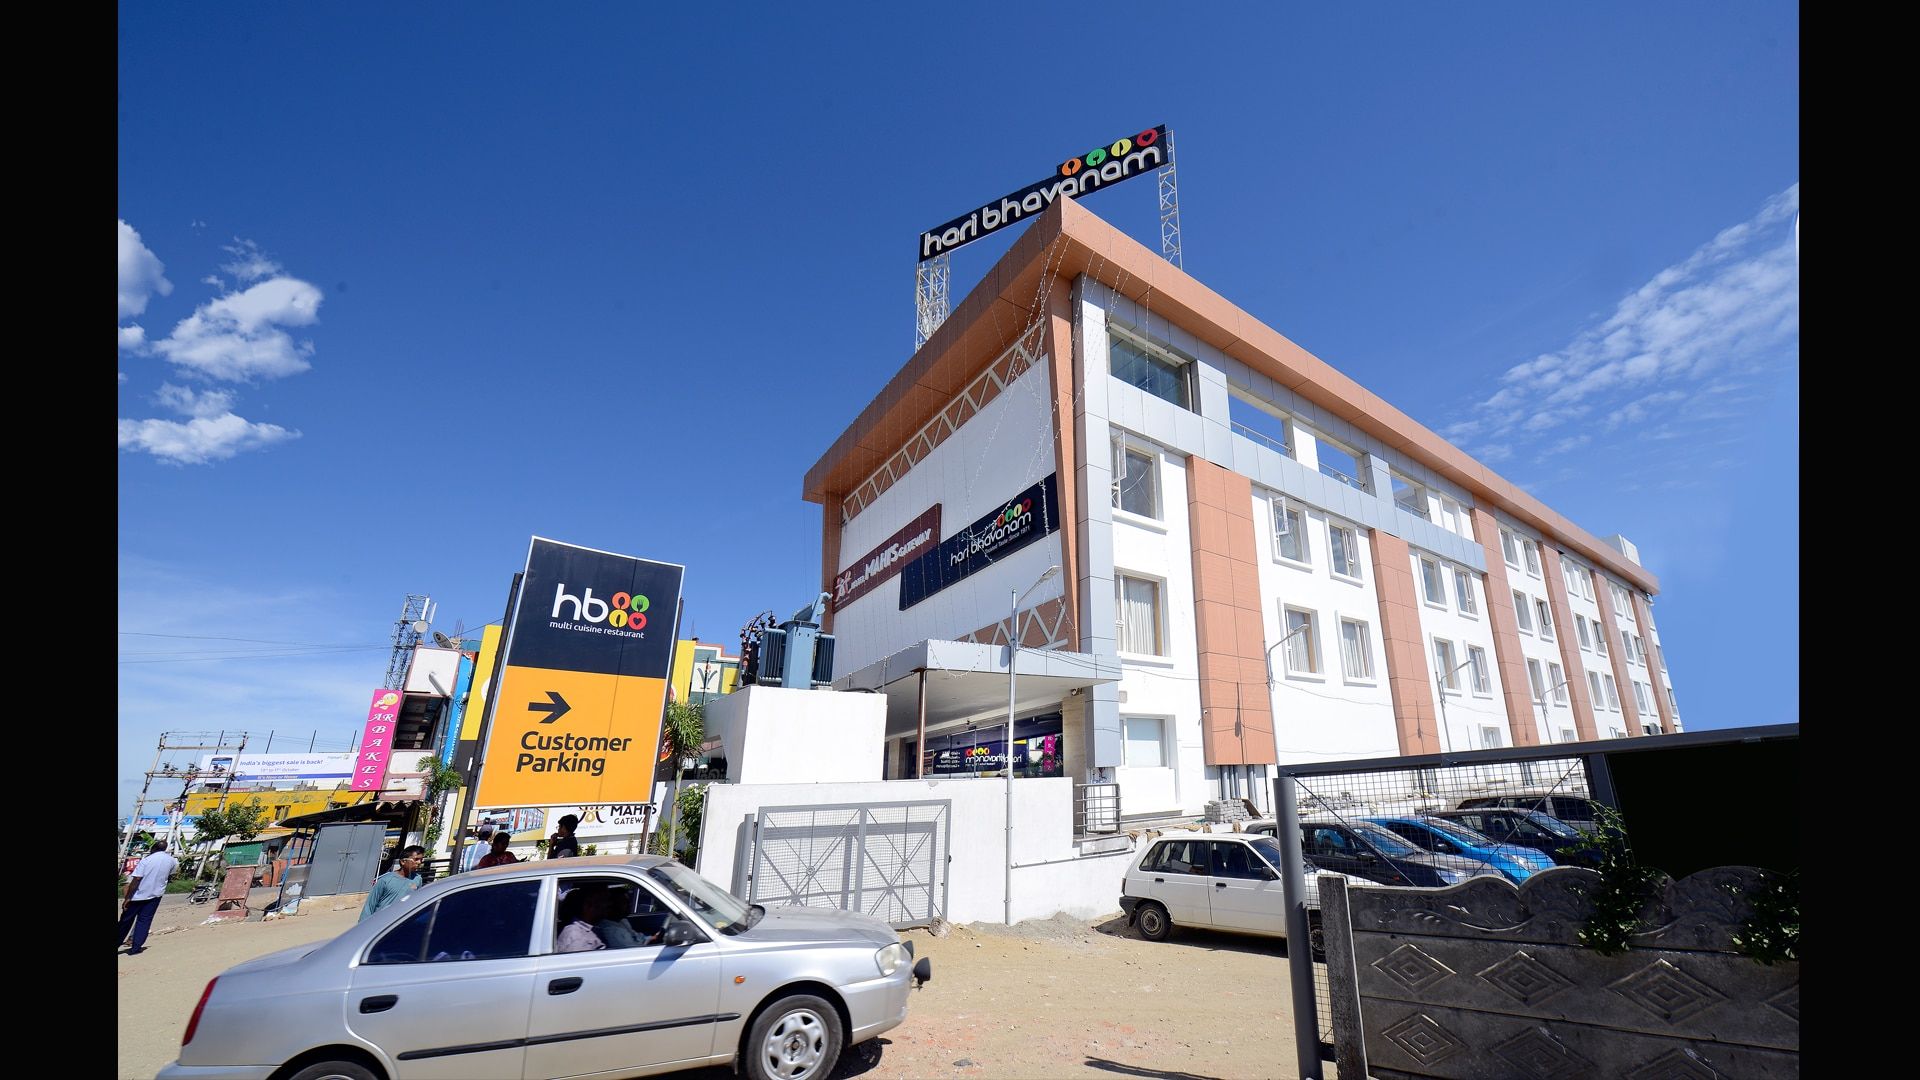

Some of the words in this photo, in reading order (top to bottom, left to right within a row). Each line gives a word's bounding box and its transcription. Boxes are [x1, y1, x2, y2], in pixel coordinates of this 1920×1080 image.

[923, 213, 977, 256] hari
[982, 146, 1160, 229] bhavanam
[898, 528, 932, 557] GATEWAY
[970, 512, 1032, 554] bhavanam
[552, 583, 609, 623] hb
[550, 621, 573, 630] multi
[574, 623, 602, 634] cuisine
[604, 628, 645, 639] restaurant
[368, 713, 397, 723] AR
[520, 730, 632, 752] Customer
[516, 752, 606, 776] Parking
